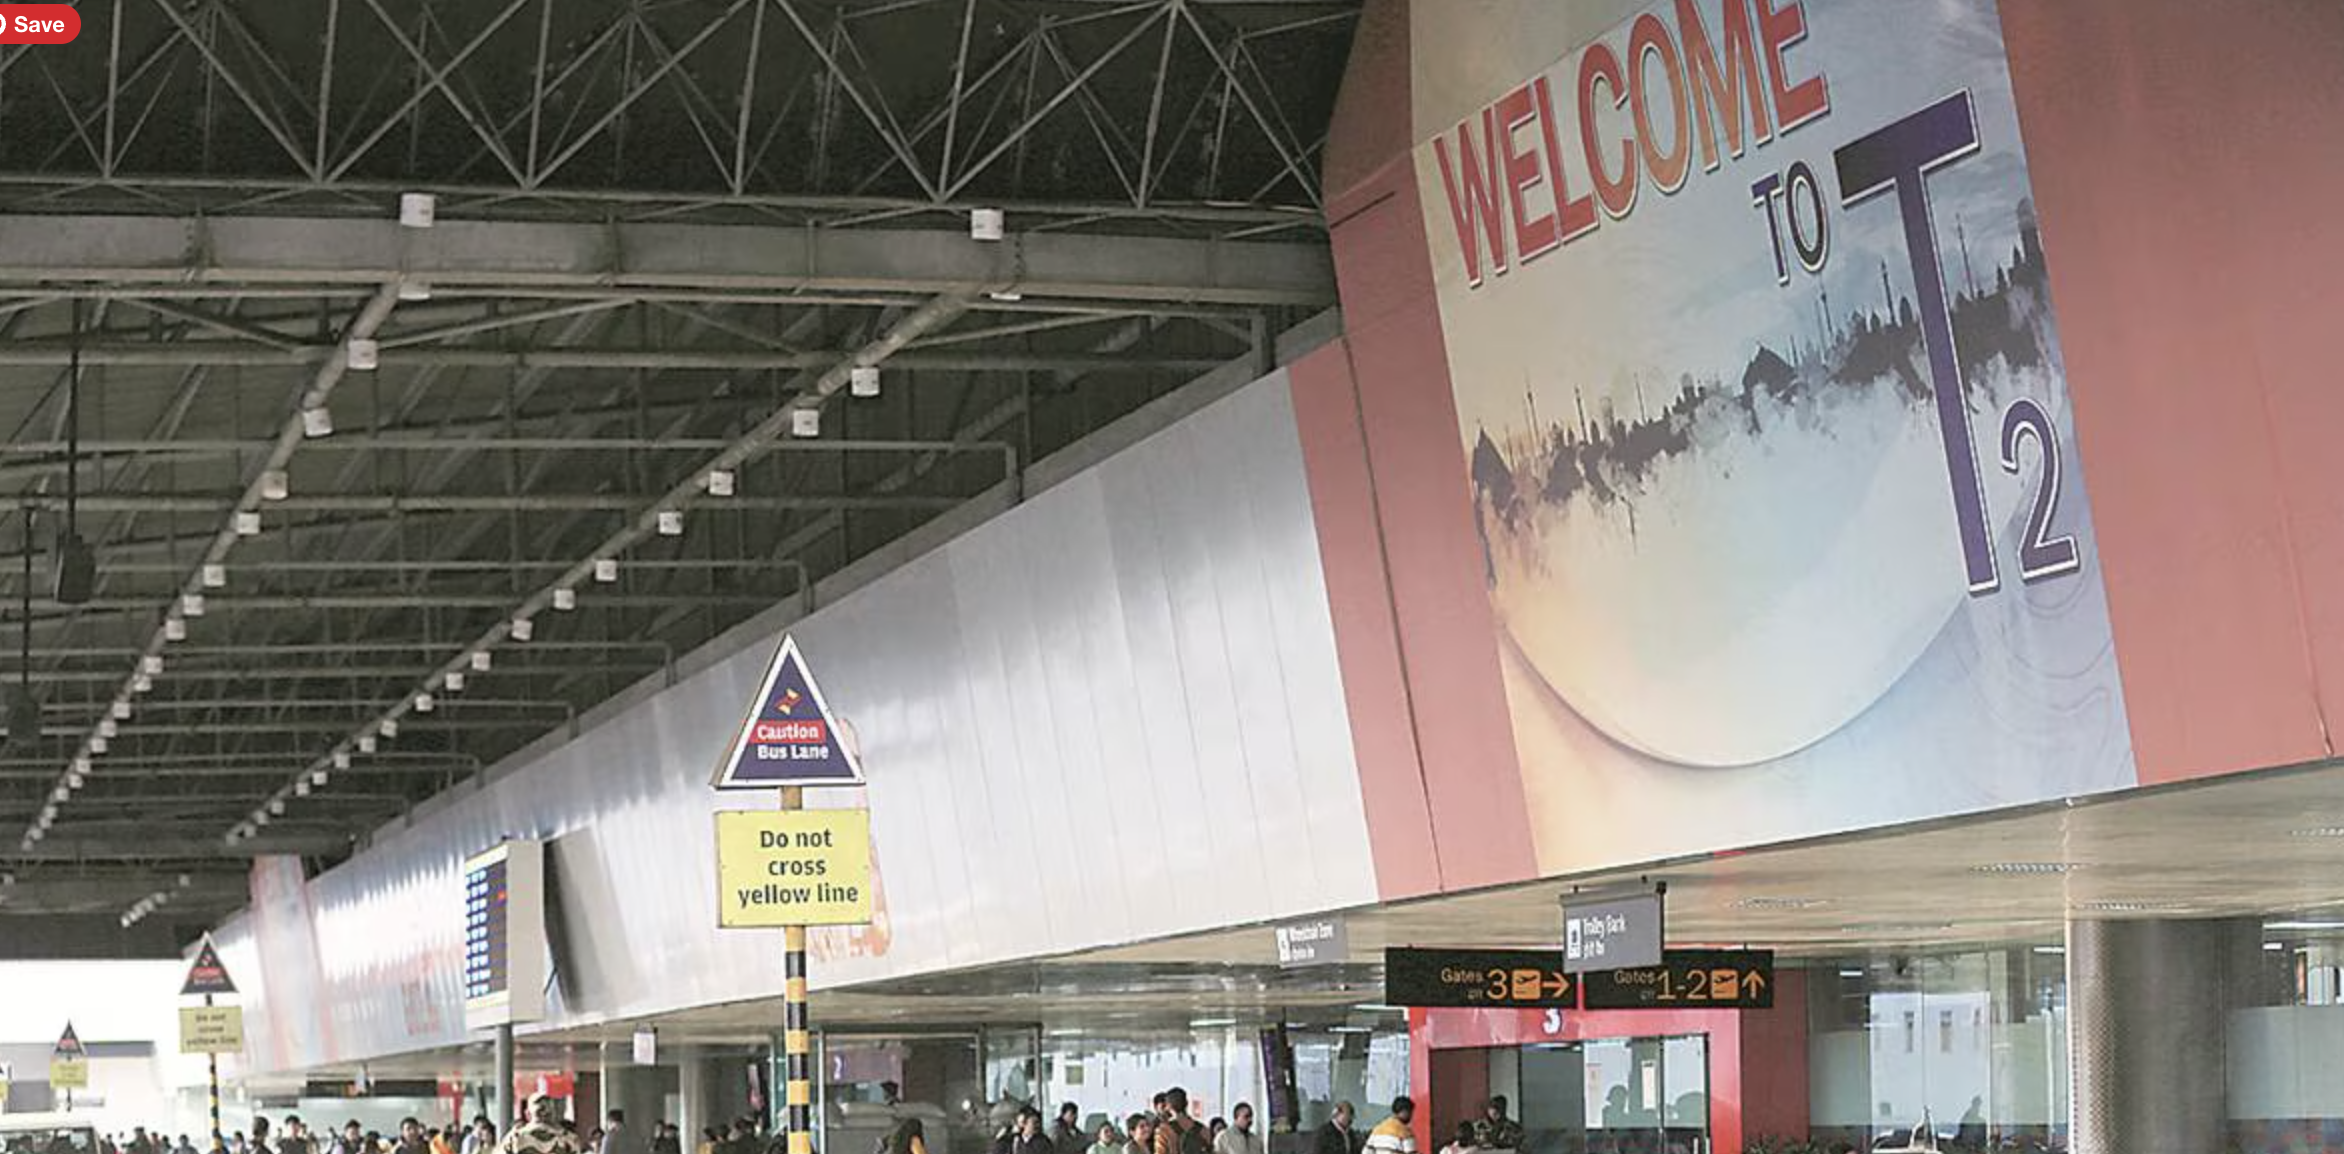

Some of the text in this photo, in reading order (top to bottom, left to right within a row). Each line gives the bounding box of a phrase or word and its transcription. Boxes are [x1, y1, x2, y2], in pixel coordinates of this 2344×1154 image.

[1432, 0, 1831, 288] WELCOME
[1751, 159, 1829, 286] TO
[757, 724, 820, 740] Caution
[757, 745, 829, 760] Bus Lane
[760, 828, 832, 848] Do not
[768, 858, 827, 876] cross
[738, 882, 859, 909] yellow line
[1441, 968, 1484, 983] Gates
[1487, 969, 1508, 999] 3
[1614, 968, 1655, 984] Gates
[1656, 969, 1708, 1000] 1-2
